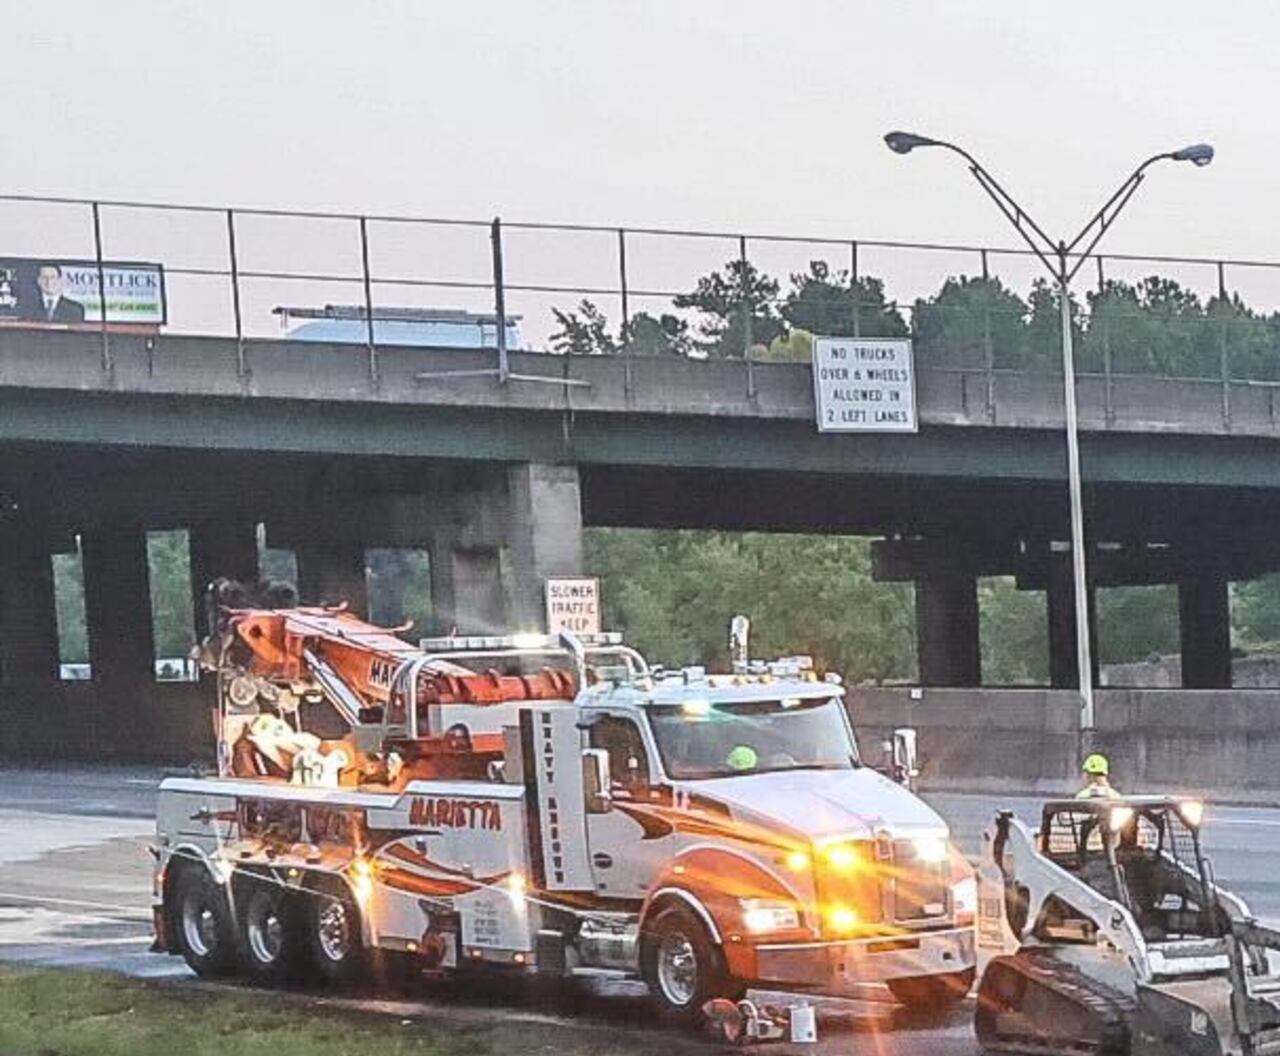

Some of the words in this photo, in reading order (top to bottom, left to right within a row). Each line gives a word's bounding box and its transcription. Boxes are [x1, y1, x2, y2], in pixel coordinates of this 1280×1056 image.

[831, 348, 847, 360] NO
[854, 347, 895, 361] TRUCKS
[820, 368, 849, 380] OVER
[866, 369, 908, 381] WHEELS
[833, 389, 882, 402] ALLOWED
[889, 391, 900, 402] IN
[827, 408, 835, 422] 2
[841, 409, 866, 422] LEFT
[874, 411, 908, 422] LANES
[551, 586, 594, 597] SLOWER
[551, 602, 596, 615] TRAFFIC
[409, 797, 502, 831] MARIETTA
